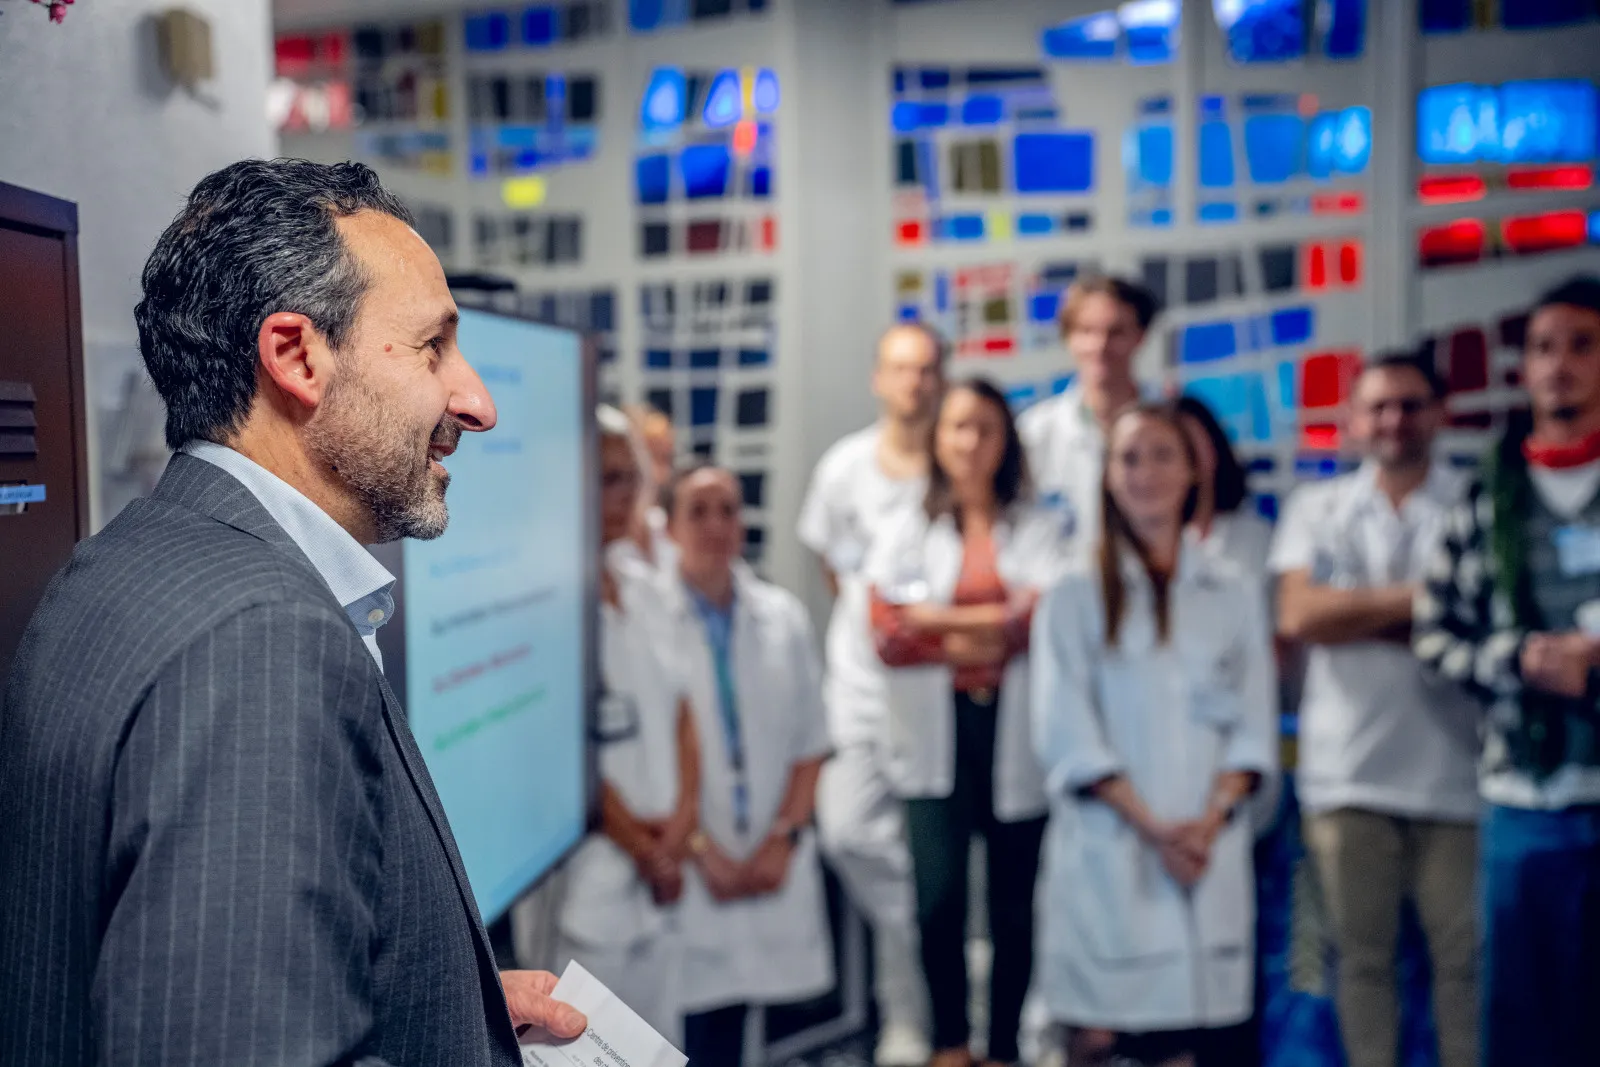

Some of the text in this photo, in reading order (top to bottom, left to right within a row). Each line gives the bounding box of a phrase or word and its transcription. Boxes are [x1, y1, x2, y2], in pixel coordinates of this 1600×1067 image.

[587, 1028, 603, 1047] Centre
[601, 1043, 609, 1052] de
[593, 1056, 604, 1067] des
